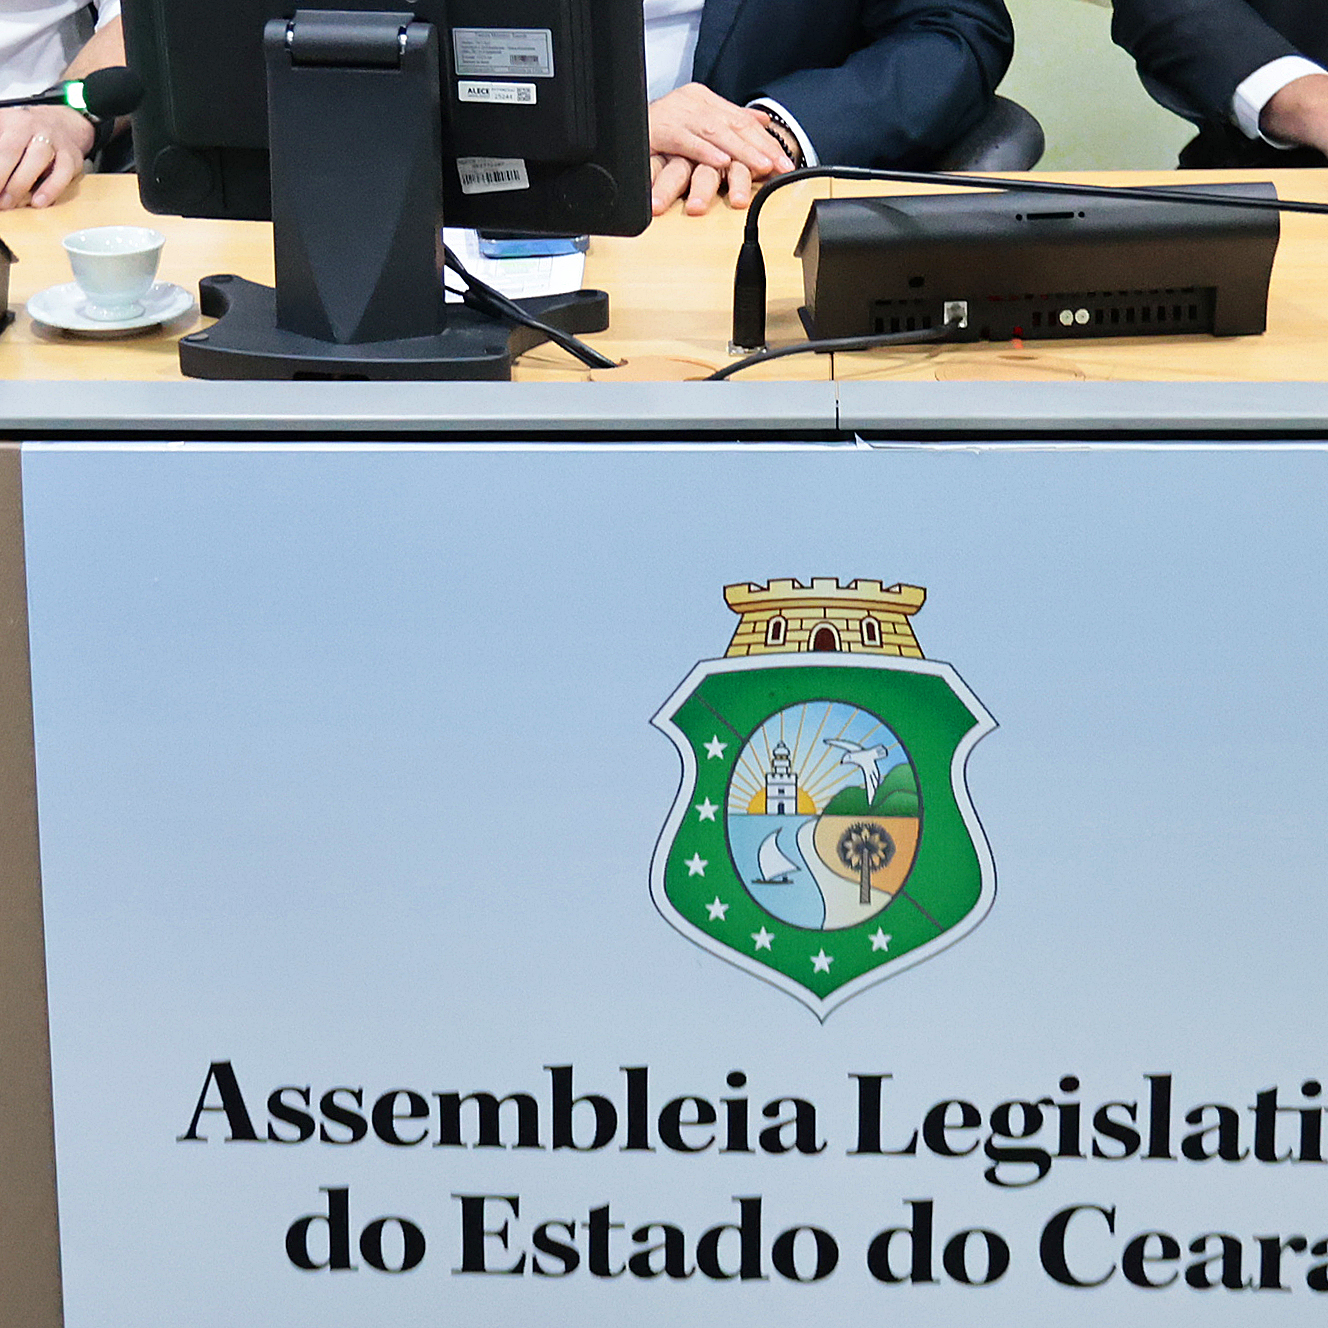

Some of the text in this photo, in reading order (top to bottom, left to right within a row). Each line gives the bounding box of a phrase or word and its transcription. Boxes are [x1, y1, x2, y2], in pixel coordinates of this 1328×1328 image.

[176, 1060, 827, 1156] Assembleia
[285, 1186, 426, 1274] do
[451, 1193, 839, 1283] Estado
[867, 1198, 1010, 1286] do
